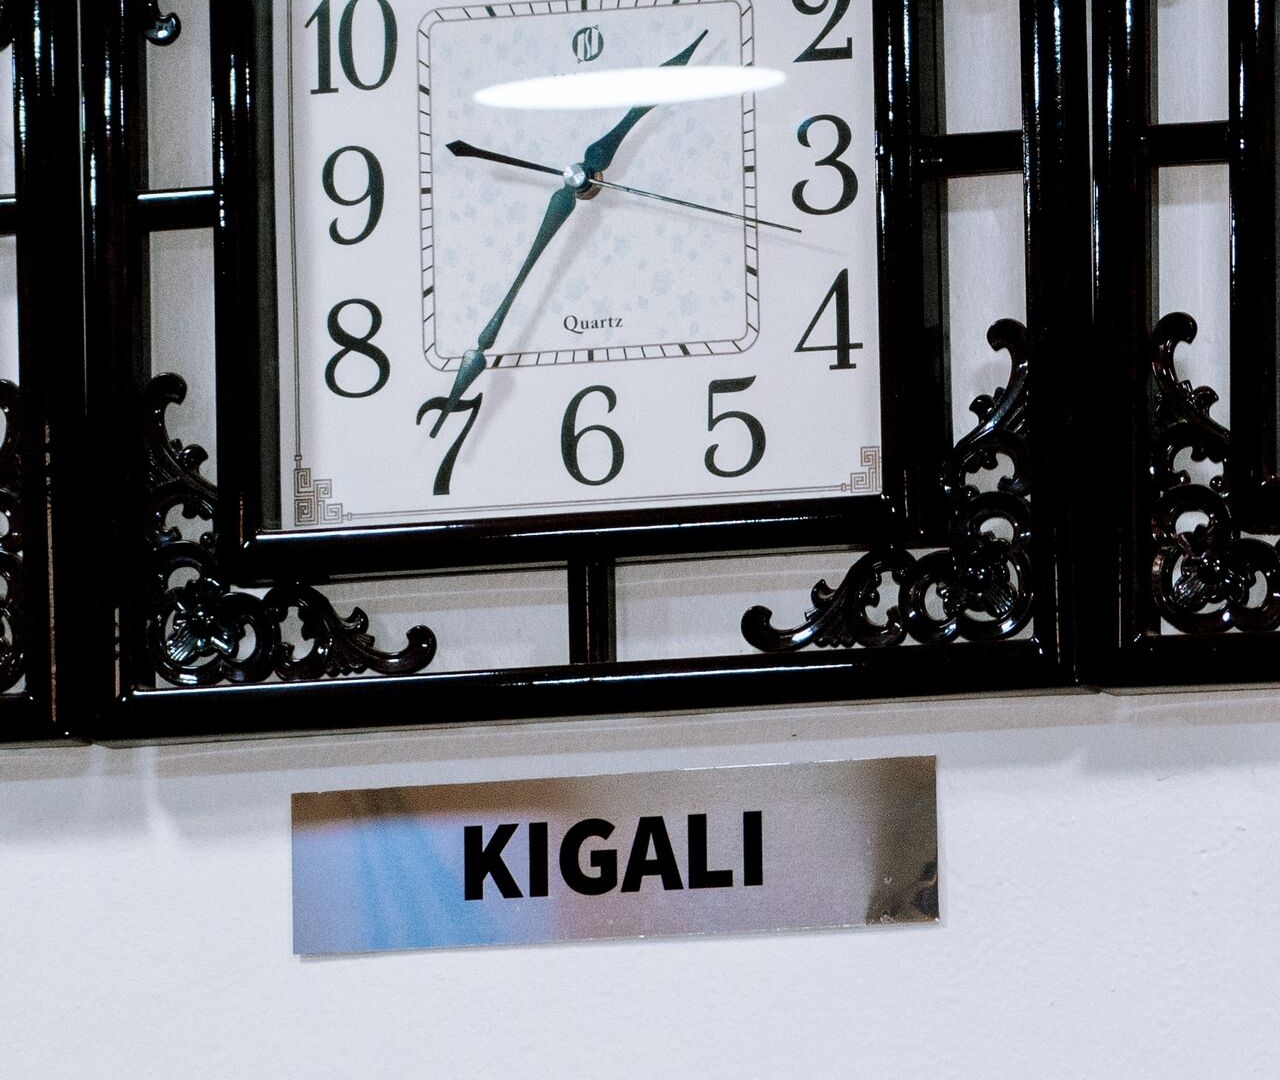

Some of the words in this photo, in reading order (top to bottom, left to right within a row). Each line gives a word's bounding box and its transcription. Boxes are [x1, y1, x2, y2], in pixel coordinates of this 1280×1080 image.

[323, 146, 384, 245] 9
[792, 115, 858, 215] 3
[325, 299, 390, 398] 8
[563, 315, 623, 334] Quartz
[795, 269, 863, 370] 4
[417, 394, 482, 495] 7
[561, 386, 624, 485] 6
[705, 376, 766, 477] 5
[463, 810, 763, 901] KIGALI
